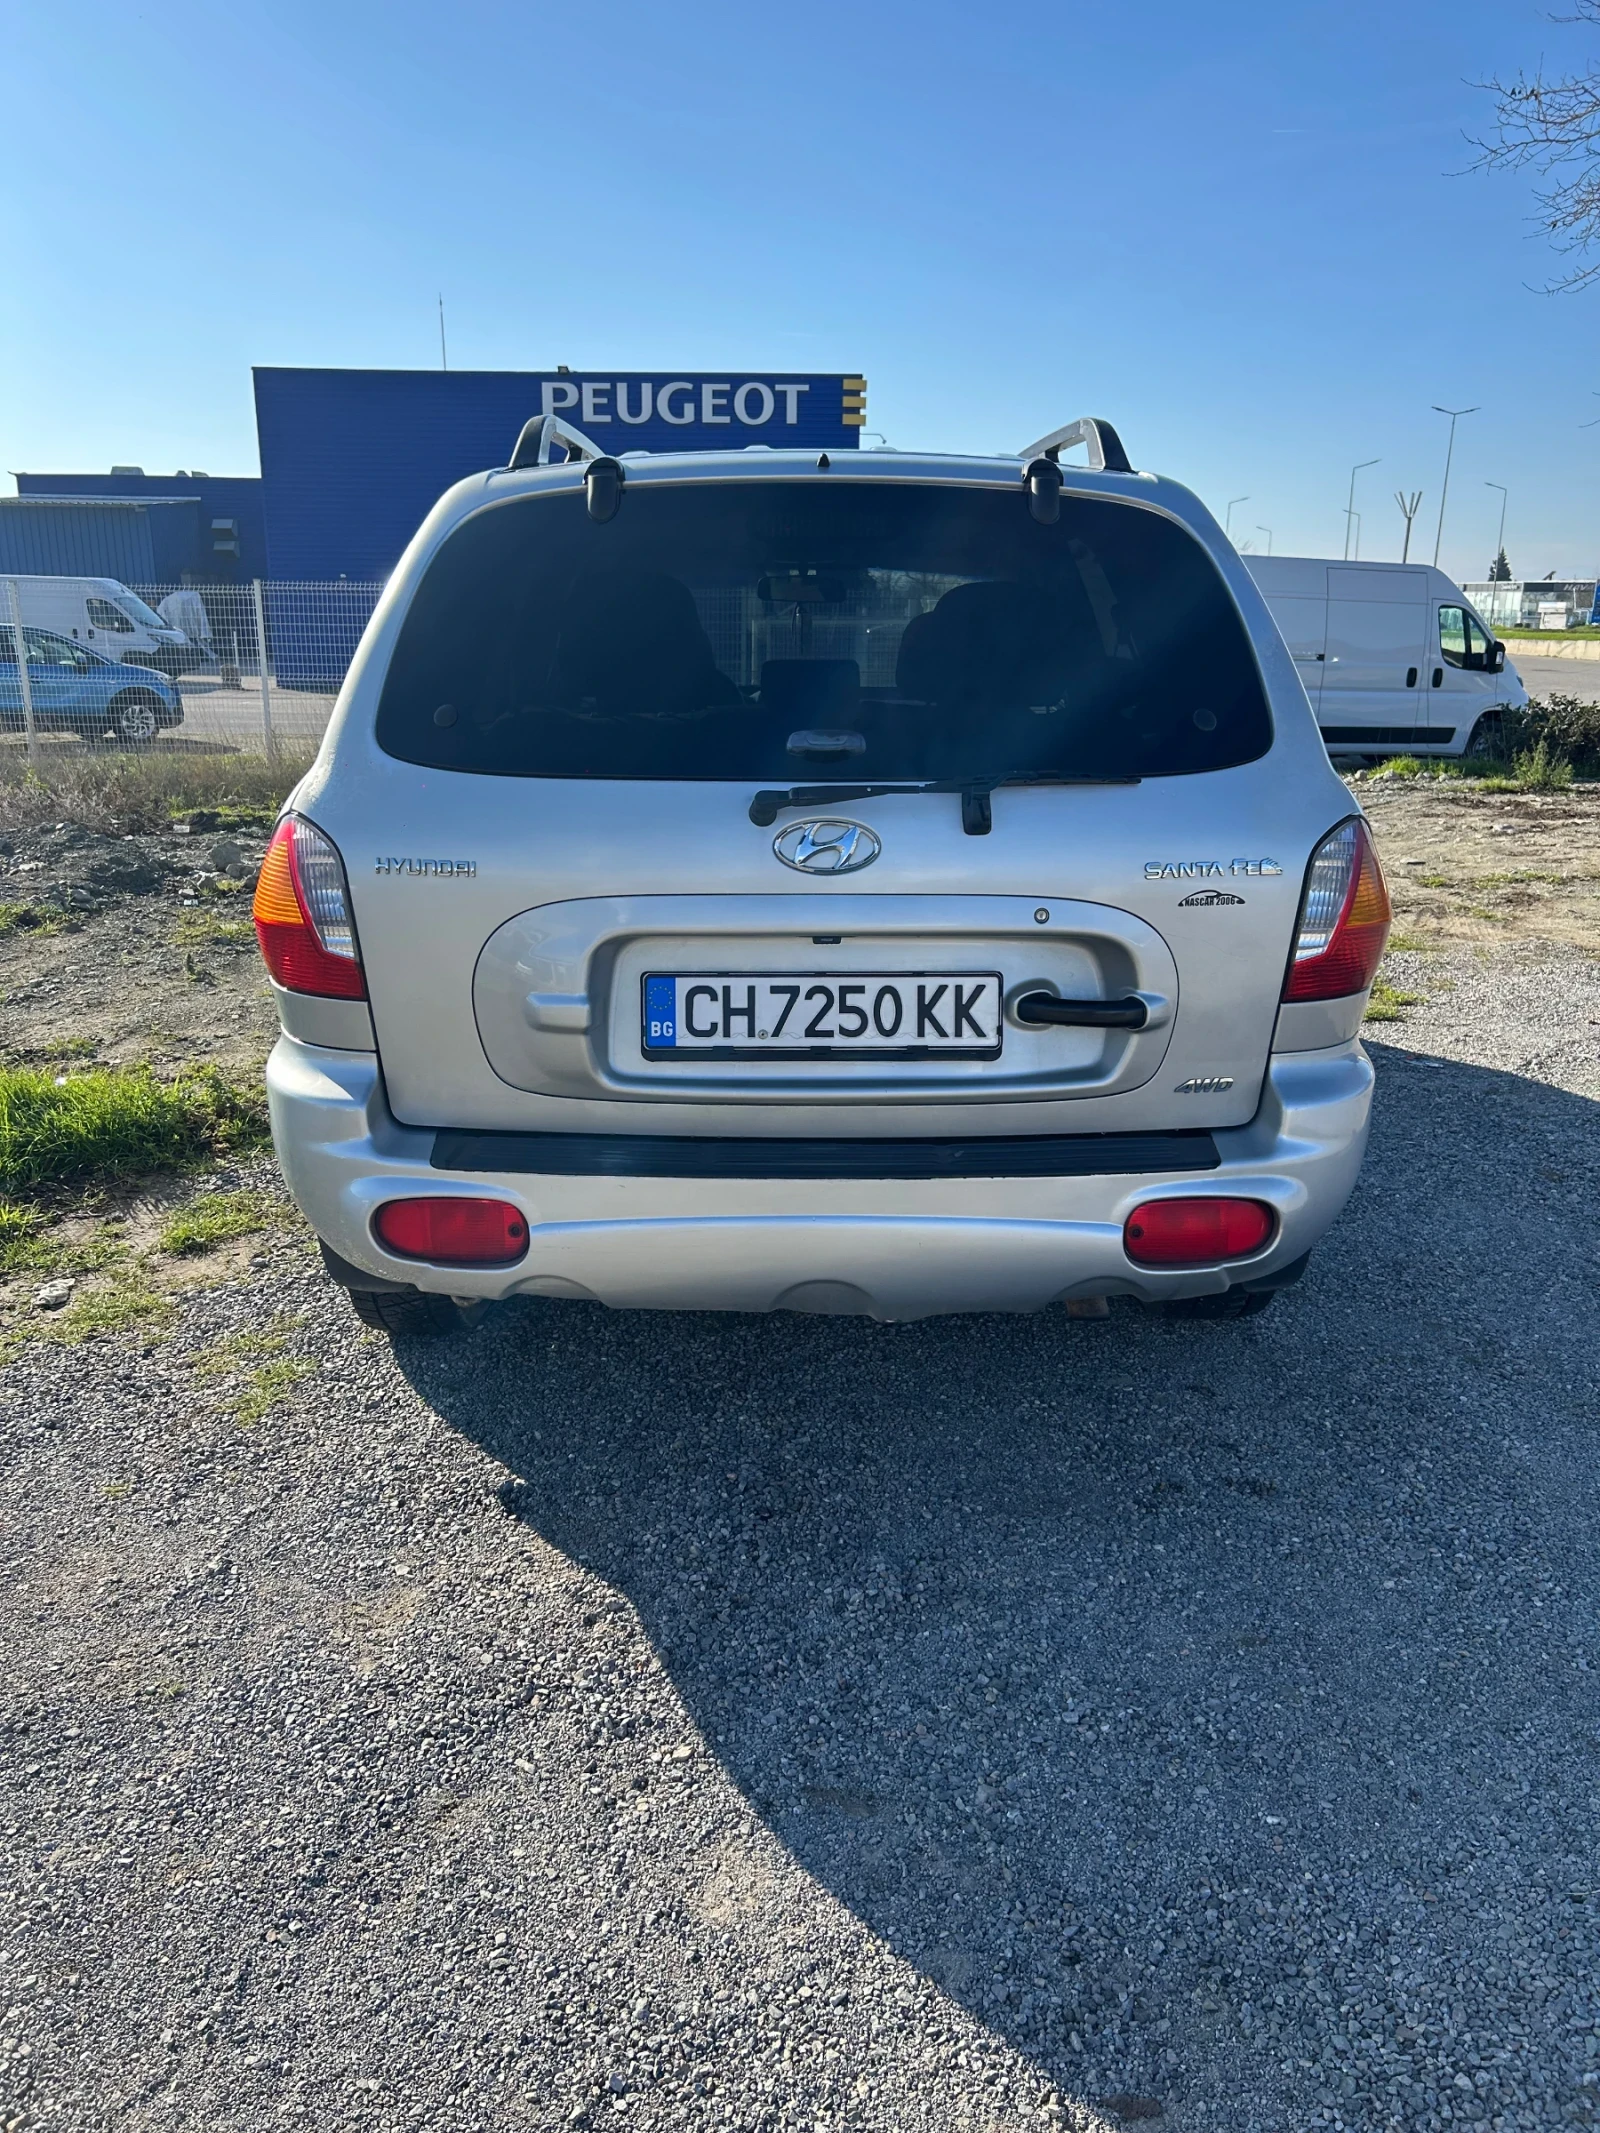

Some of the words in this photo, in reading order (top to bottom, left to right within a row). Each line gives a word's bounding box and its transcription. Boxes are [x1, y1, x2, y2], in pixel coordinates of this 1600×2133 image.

[541, 382, 809, 425] PEUGEOT
[375, 857, 477, 878] HYUNDAI
[1144, 861, 1225, 880] SANTA
[1229, 858, 1261, 876] FE
[1184, 897, 1215, 907] NASCAR
[1216, 896, 1236, 906] 2006
[651, 1021, 673, 1037] BG
[1174, 1077, 1234, 1093] 4WD
